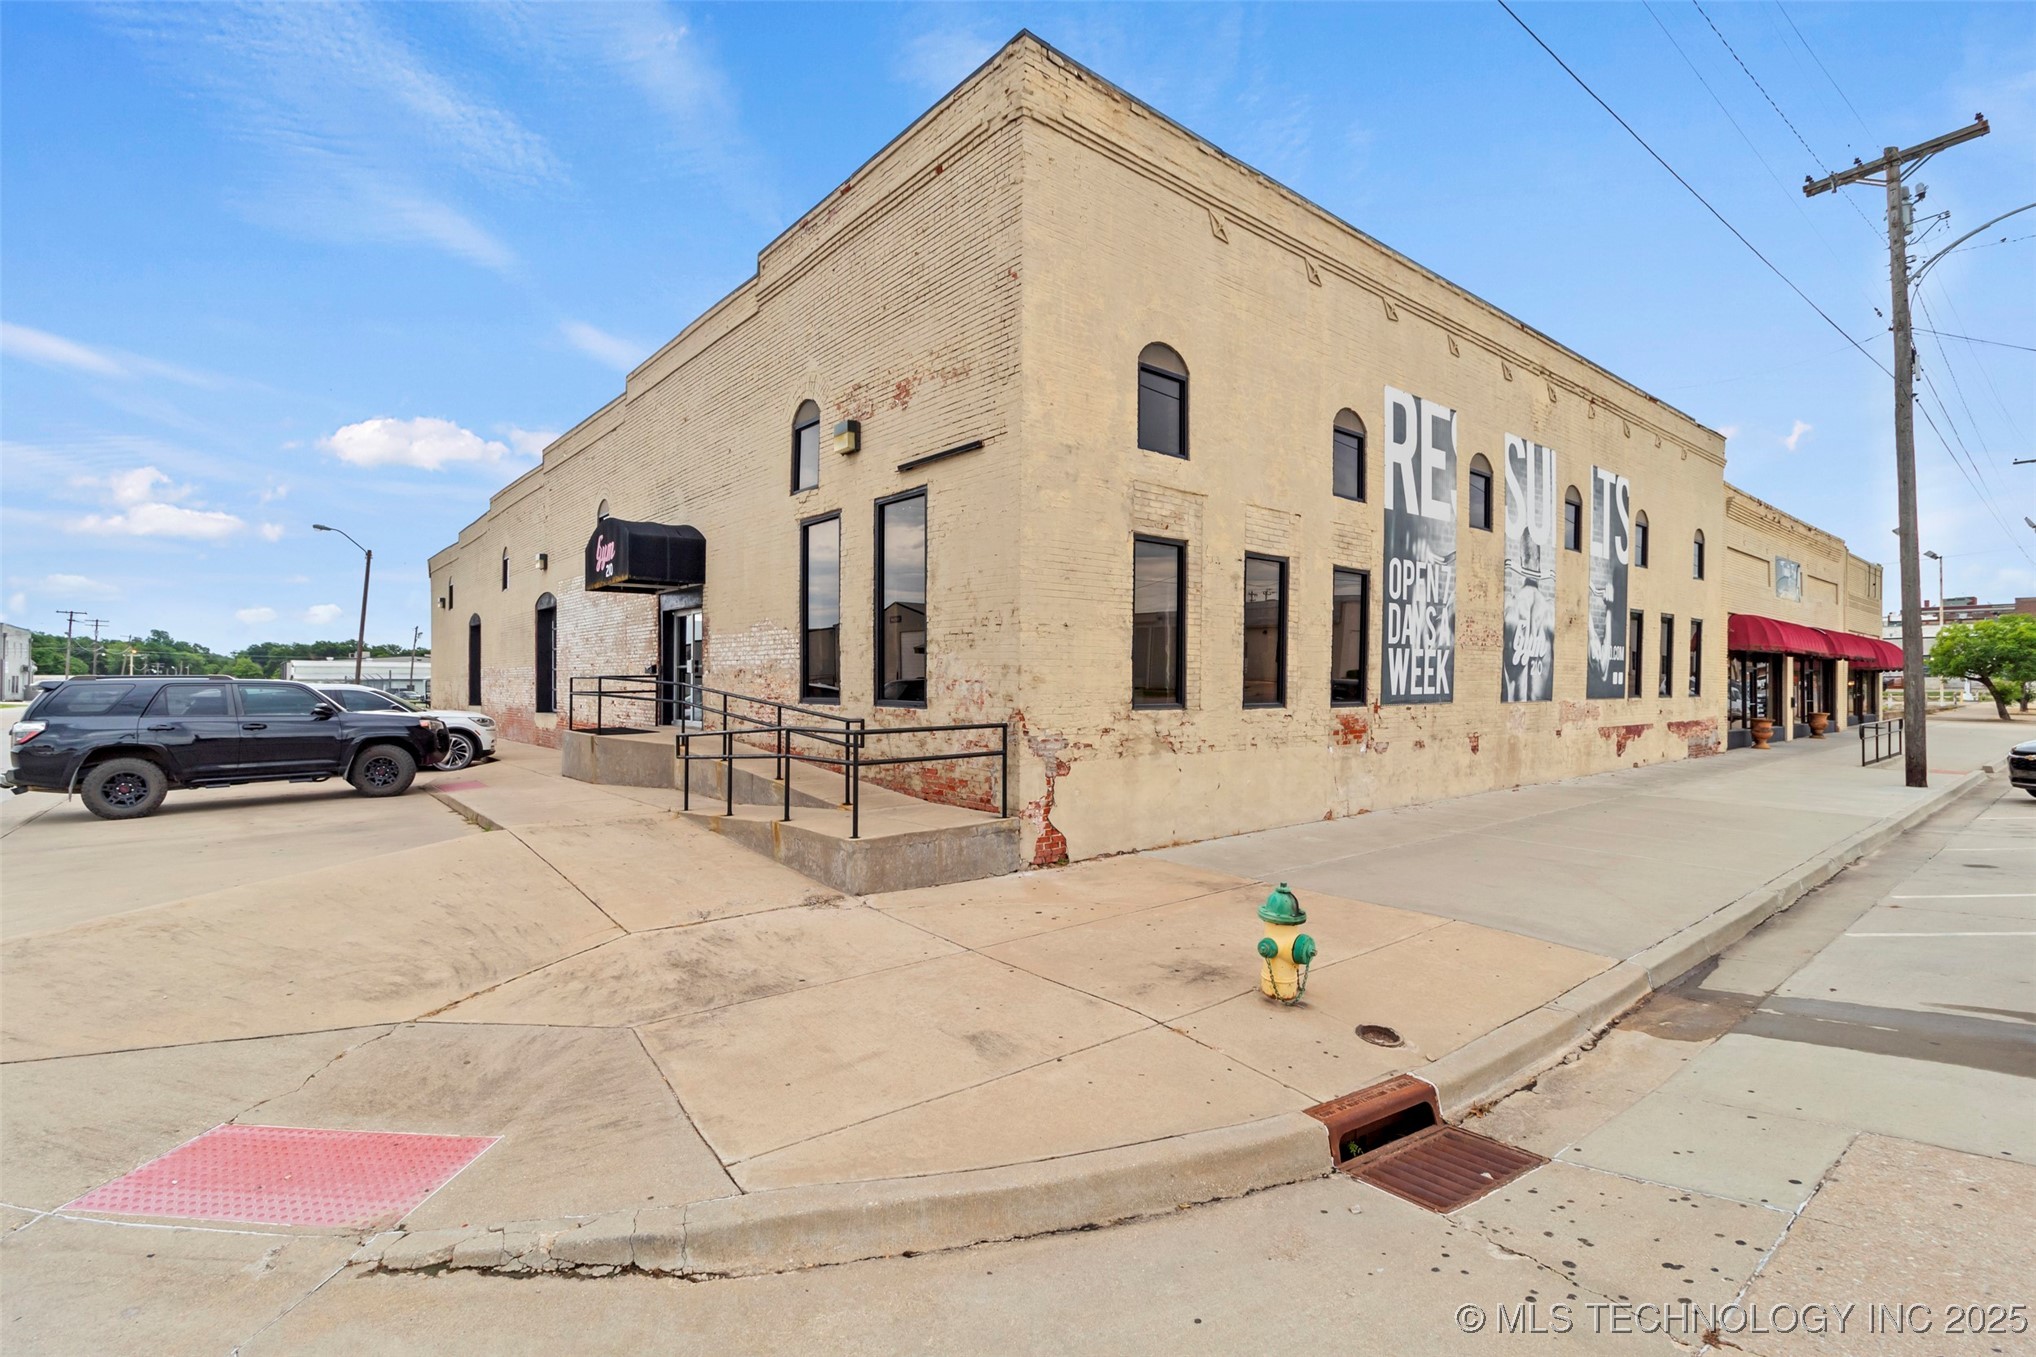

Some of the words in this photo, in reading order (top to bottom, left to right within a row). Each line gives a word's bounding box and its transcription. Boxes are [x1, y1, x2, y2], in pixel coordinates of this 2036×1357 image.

[1384, 384, 1457, 522] RE
[1388, 557, 1439, 604] OPEN
[1441, 565, 1452, 604] 7
[1387, 602, 1437, 646] DAYS
[1438, 607, 1451, 646] A
[1387, 647, 1450, 696] WEEK
